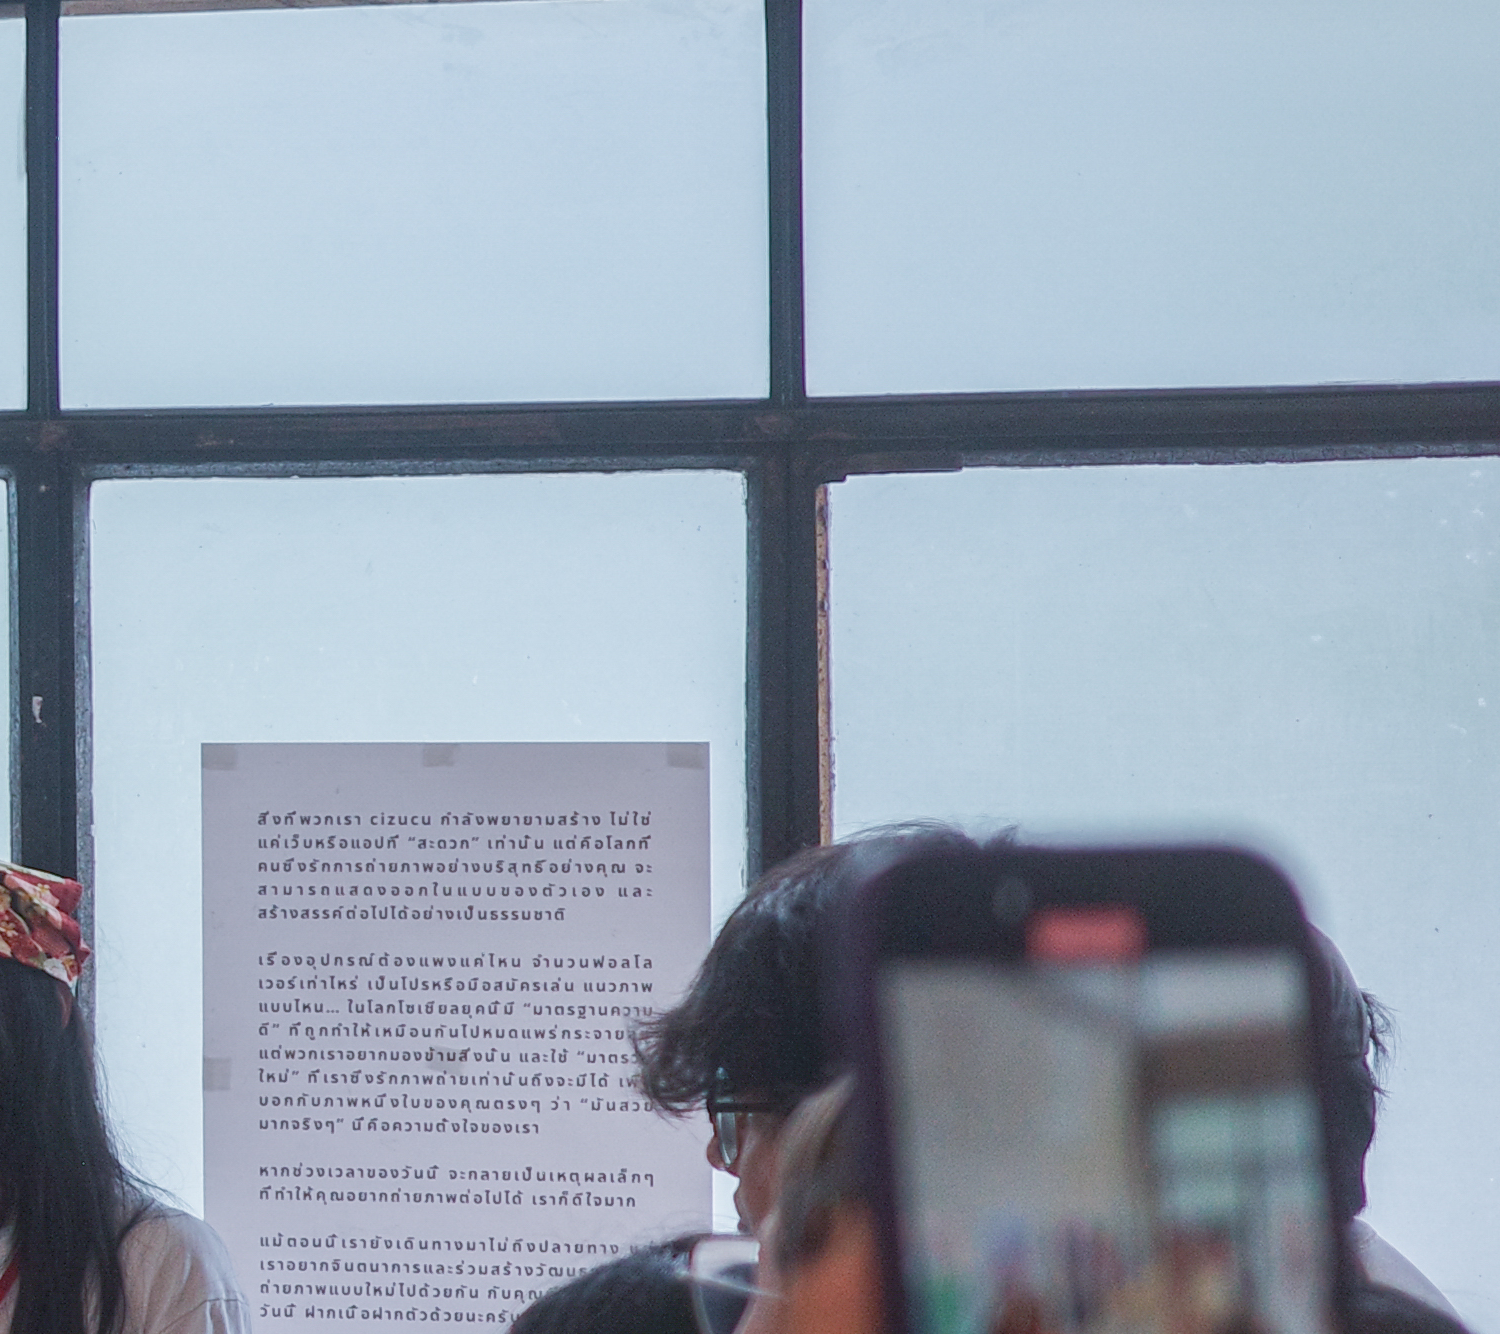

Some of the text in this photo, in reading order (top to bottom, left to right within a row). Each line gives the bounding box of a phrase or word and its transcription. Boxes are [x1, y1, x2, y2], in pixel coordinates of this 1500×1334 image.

[370, 812, 432, 826] cizucu
[610, 811, 652, 827] ไม่ใช่
[618, 885, 654, 898] และ
[583, 982, 653, 994] แนวภาพ
